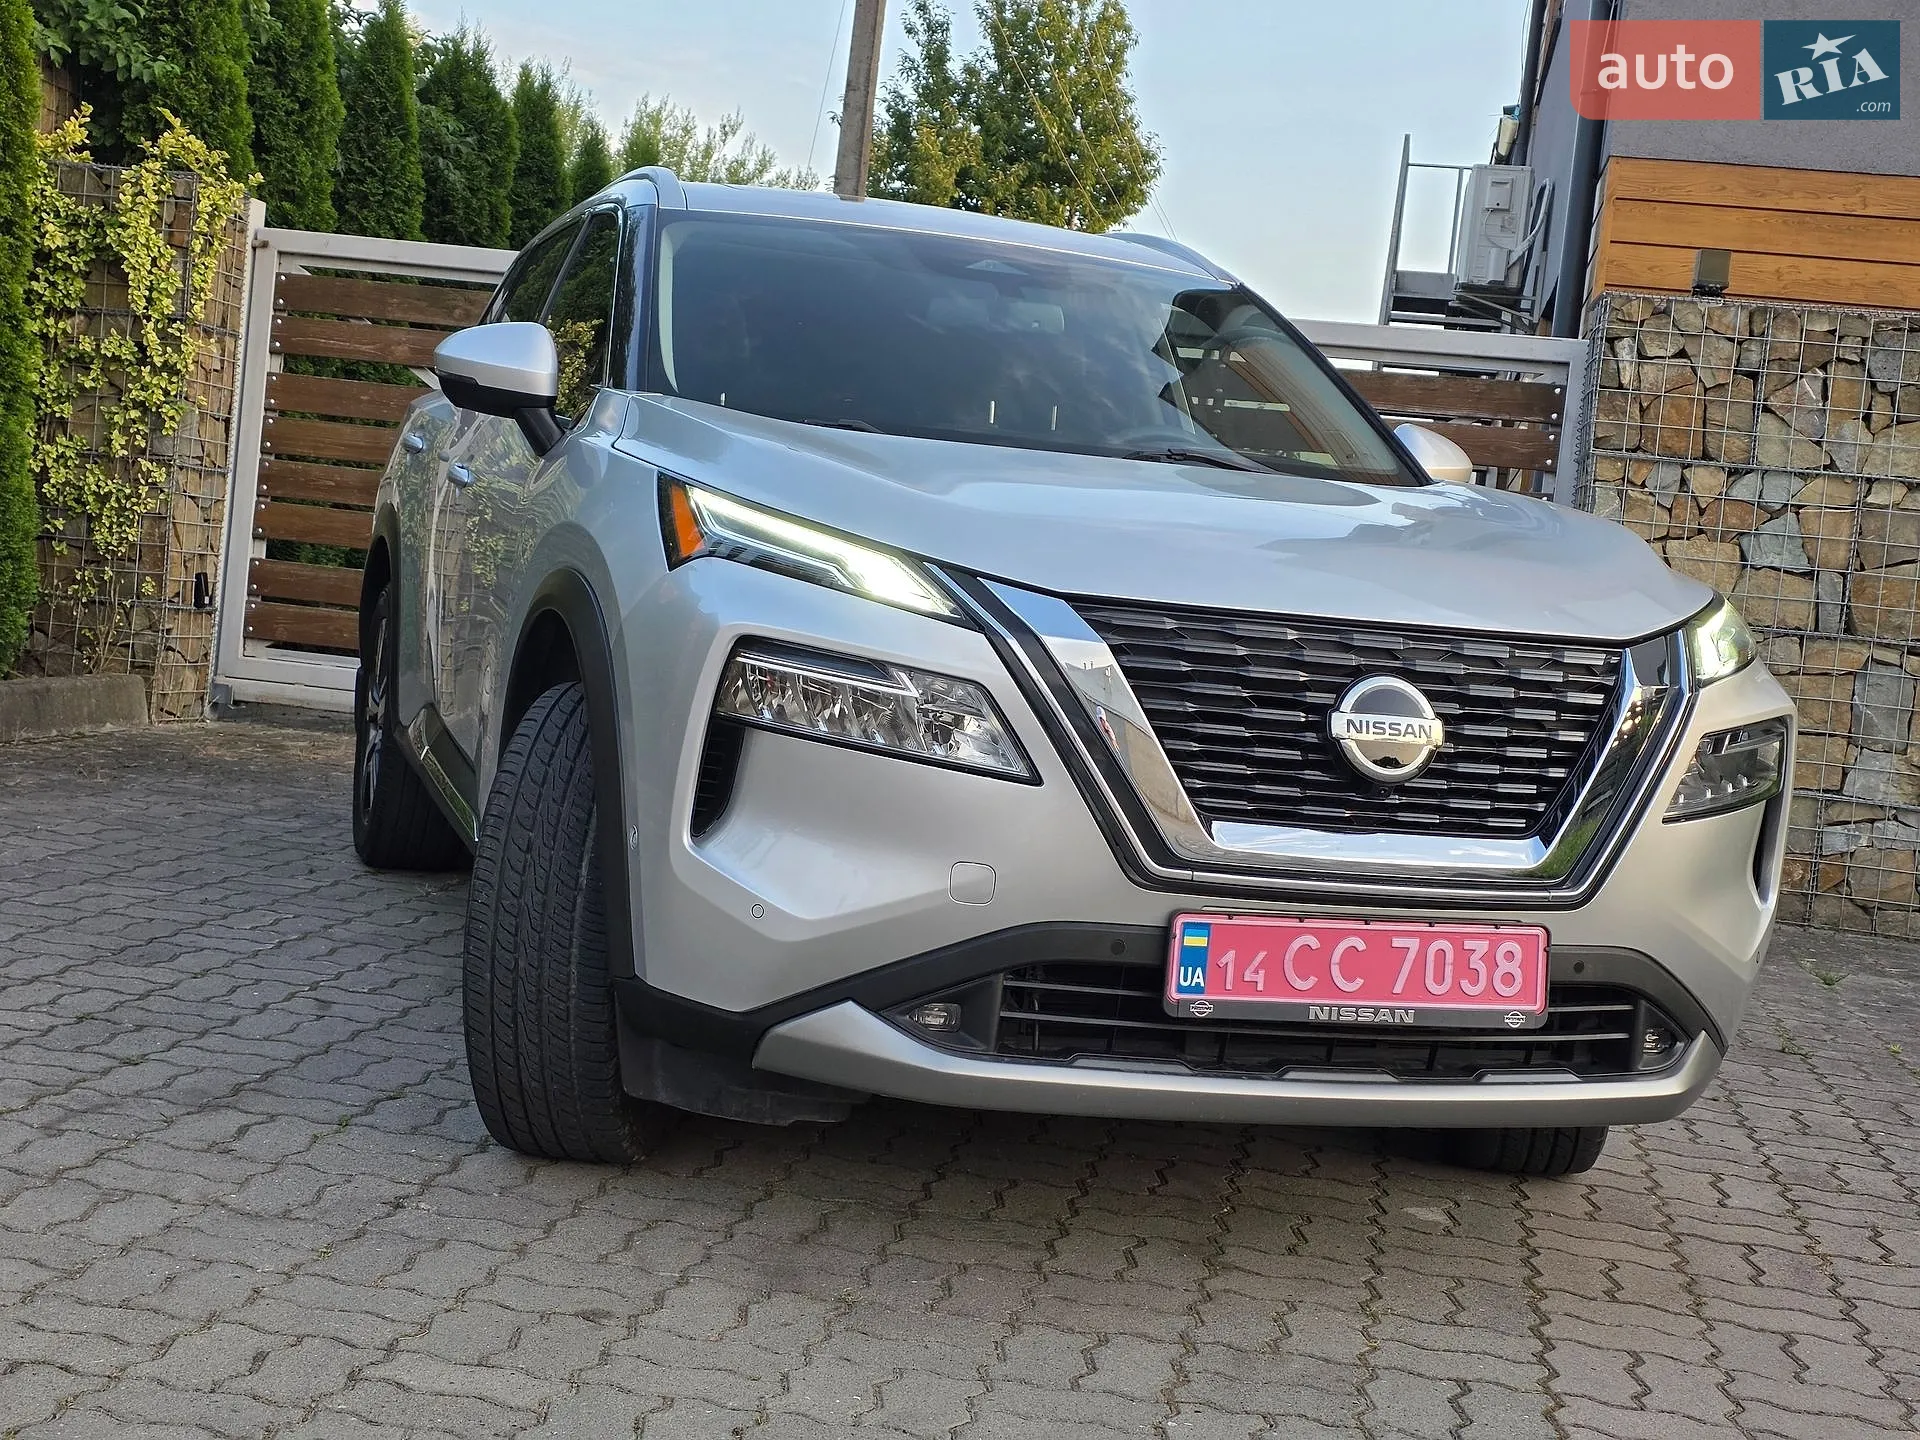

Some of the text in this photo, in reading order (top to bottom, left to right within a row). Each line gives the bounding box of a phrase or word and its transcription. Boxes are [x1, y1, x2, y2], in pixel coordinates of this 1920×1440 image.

[1346, 718, 1432, 739] NISSAN
[1216, 934, 1524, 998] 14 CC 7038
[1179, 966, 1205, 988] UA
[1308, 1005, 1416, 1025] NISSAN
